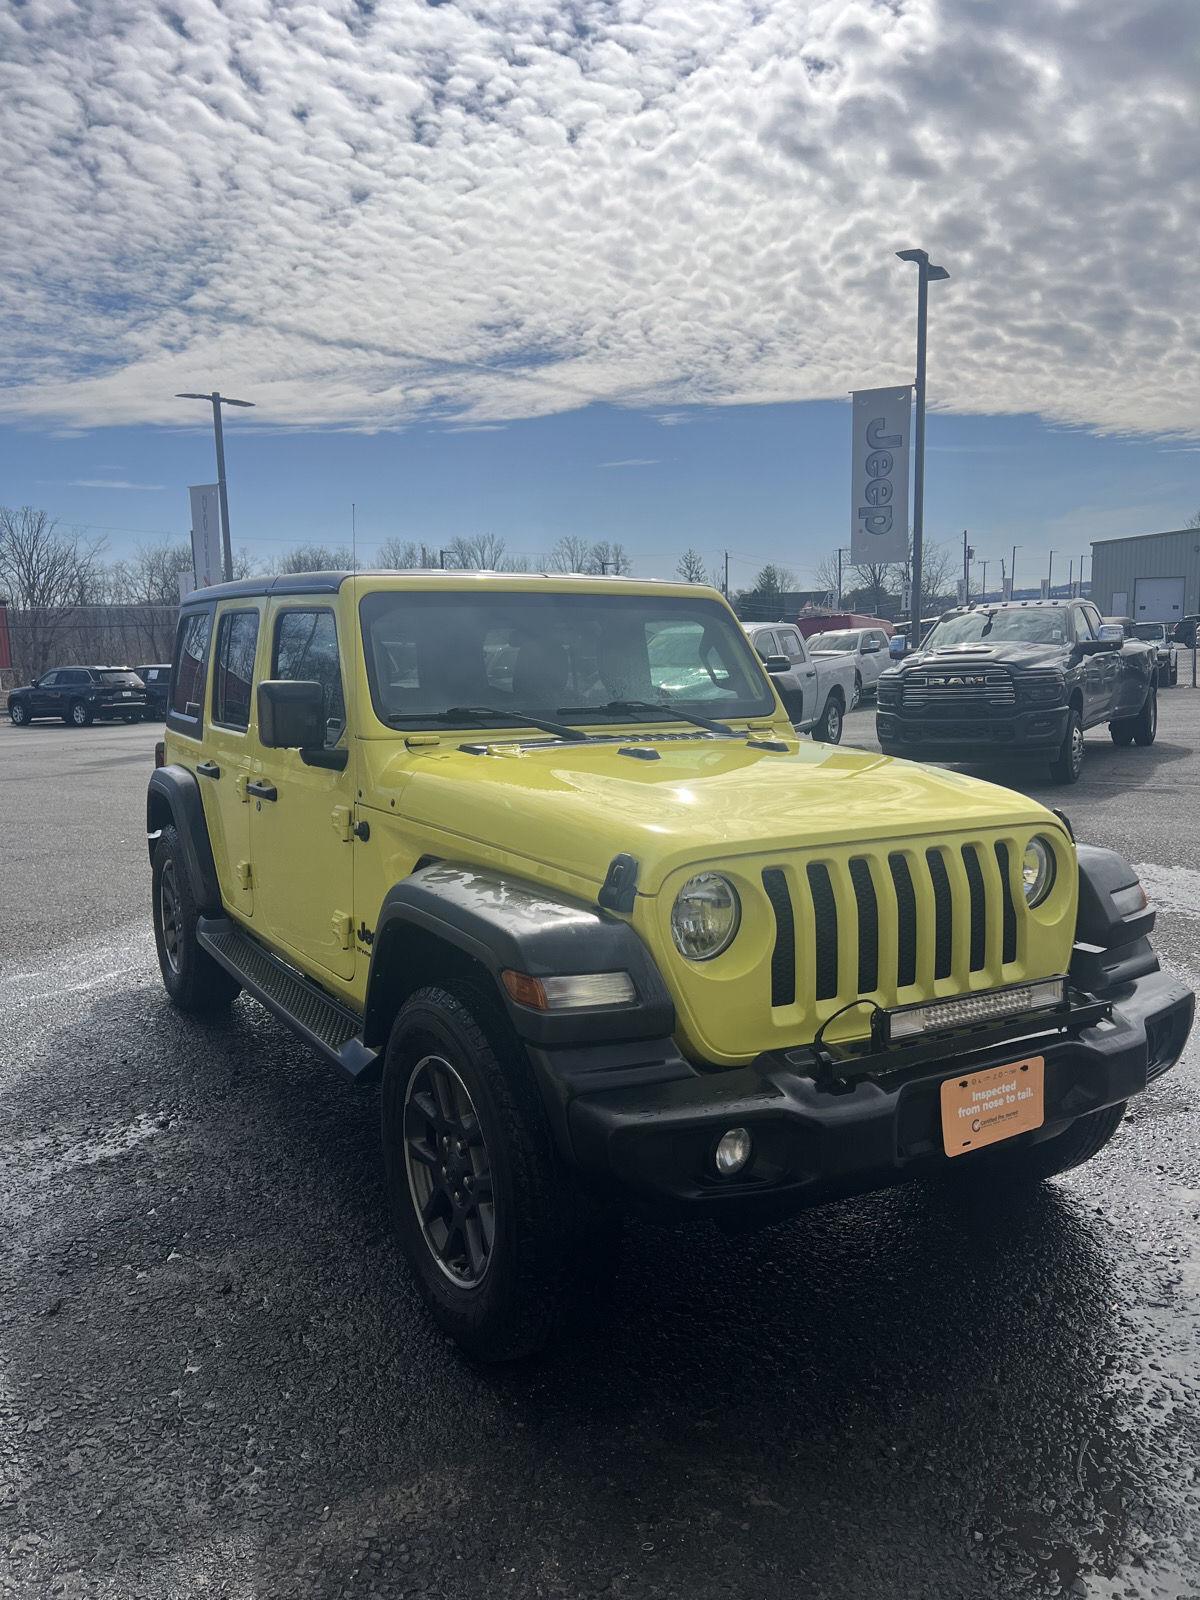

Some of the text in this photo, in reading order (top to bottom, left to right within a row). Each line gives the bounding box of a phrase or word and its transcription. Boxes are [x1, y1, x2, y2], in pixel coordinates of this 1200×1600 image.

[858, 417, 903, 535] Jeep
[928, 676, 985, 686] RAM
[958, 1087, 1034, 1118] from nose to tail.
[972, 1080, 1017, 1101] Inspected
